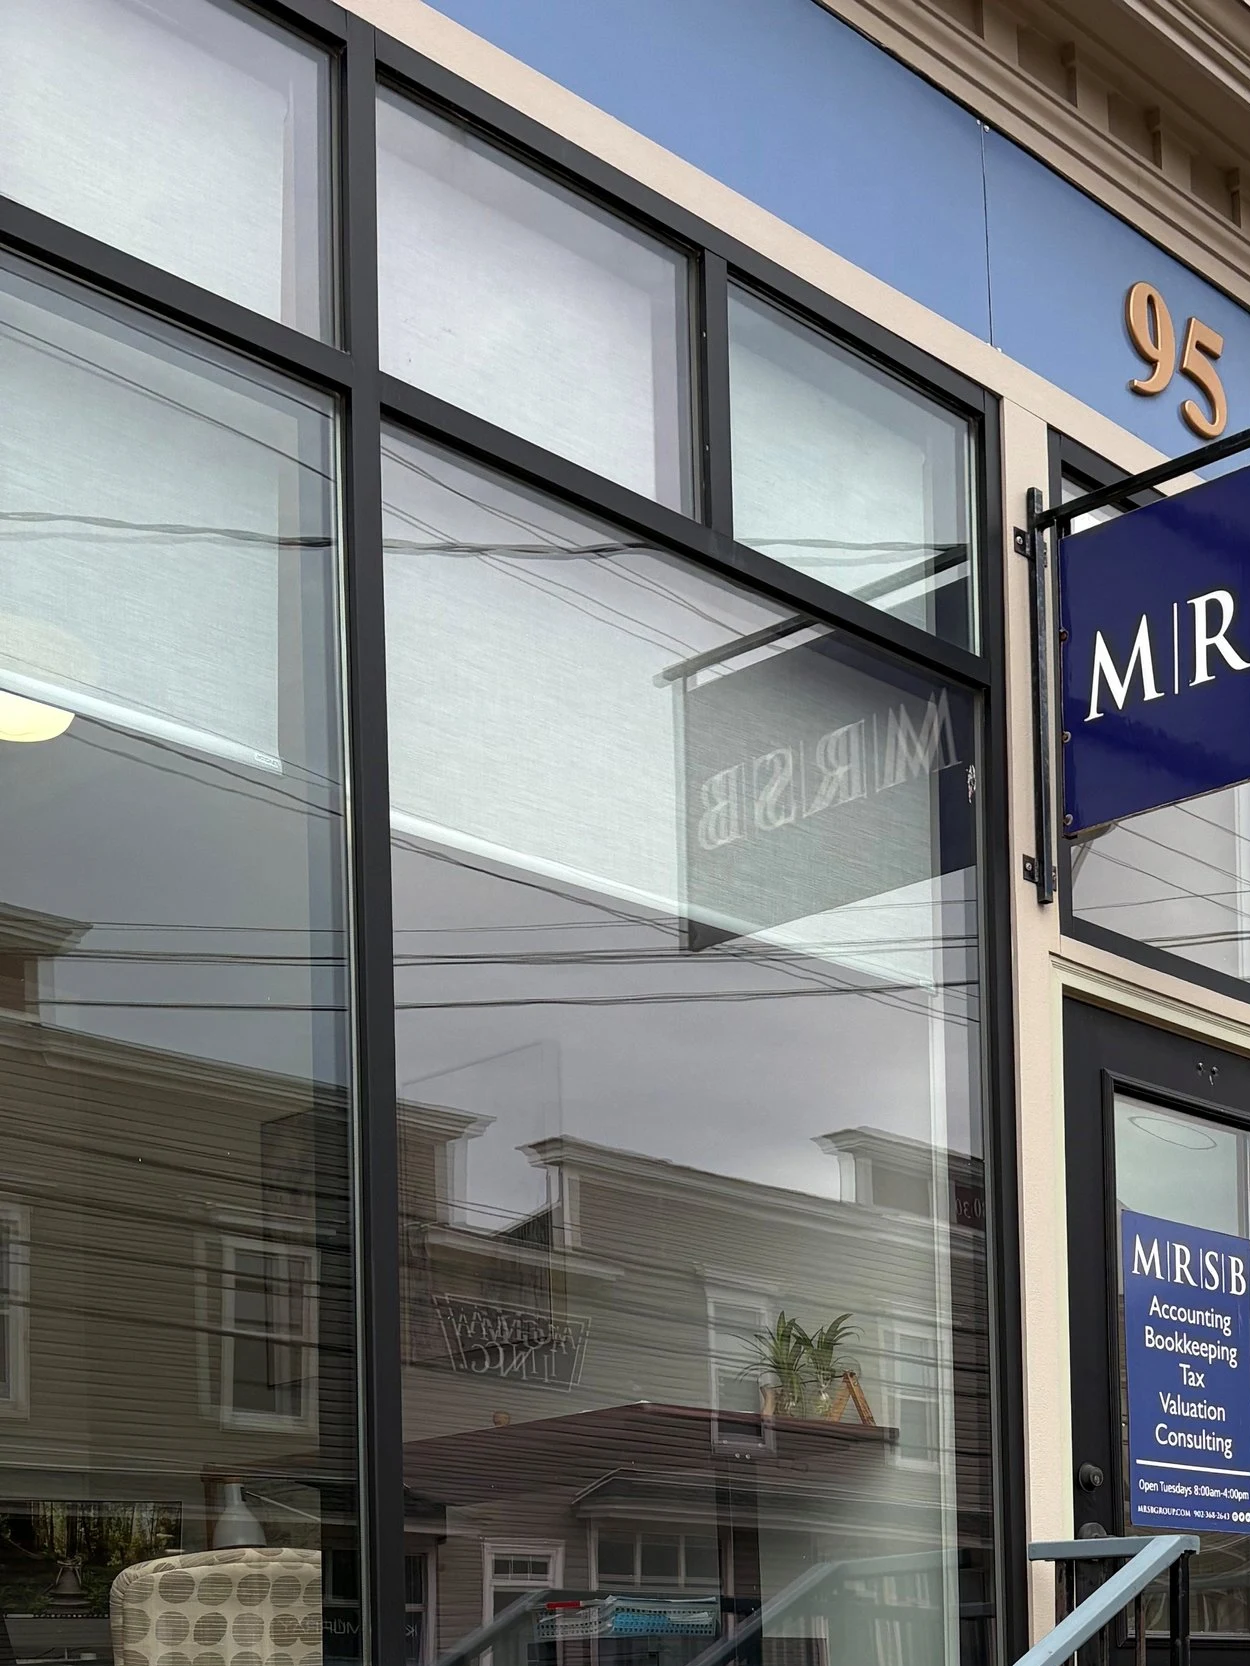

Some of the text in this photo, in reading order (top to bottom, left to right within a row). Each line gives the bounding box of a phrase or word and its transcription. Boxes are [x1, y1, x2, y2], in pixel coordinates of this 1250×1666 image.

[1125, 280, 1228, 439] 95
[1149, 1295, 1232, 1337] Accounting
[1145, 1325, 1238, 1369] Bookkeeping
[1179, 1363, 1205, 1388] Tax
[1159, 1391, 1226, 1421] Valuation
[1155, 1423, 1233, 1459] Consulting
[1138, 1479, 1249, 1501] Open Tuesdays 8:00am-4:00pm
